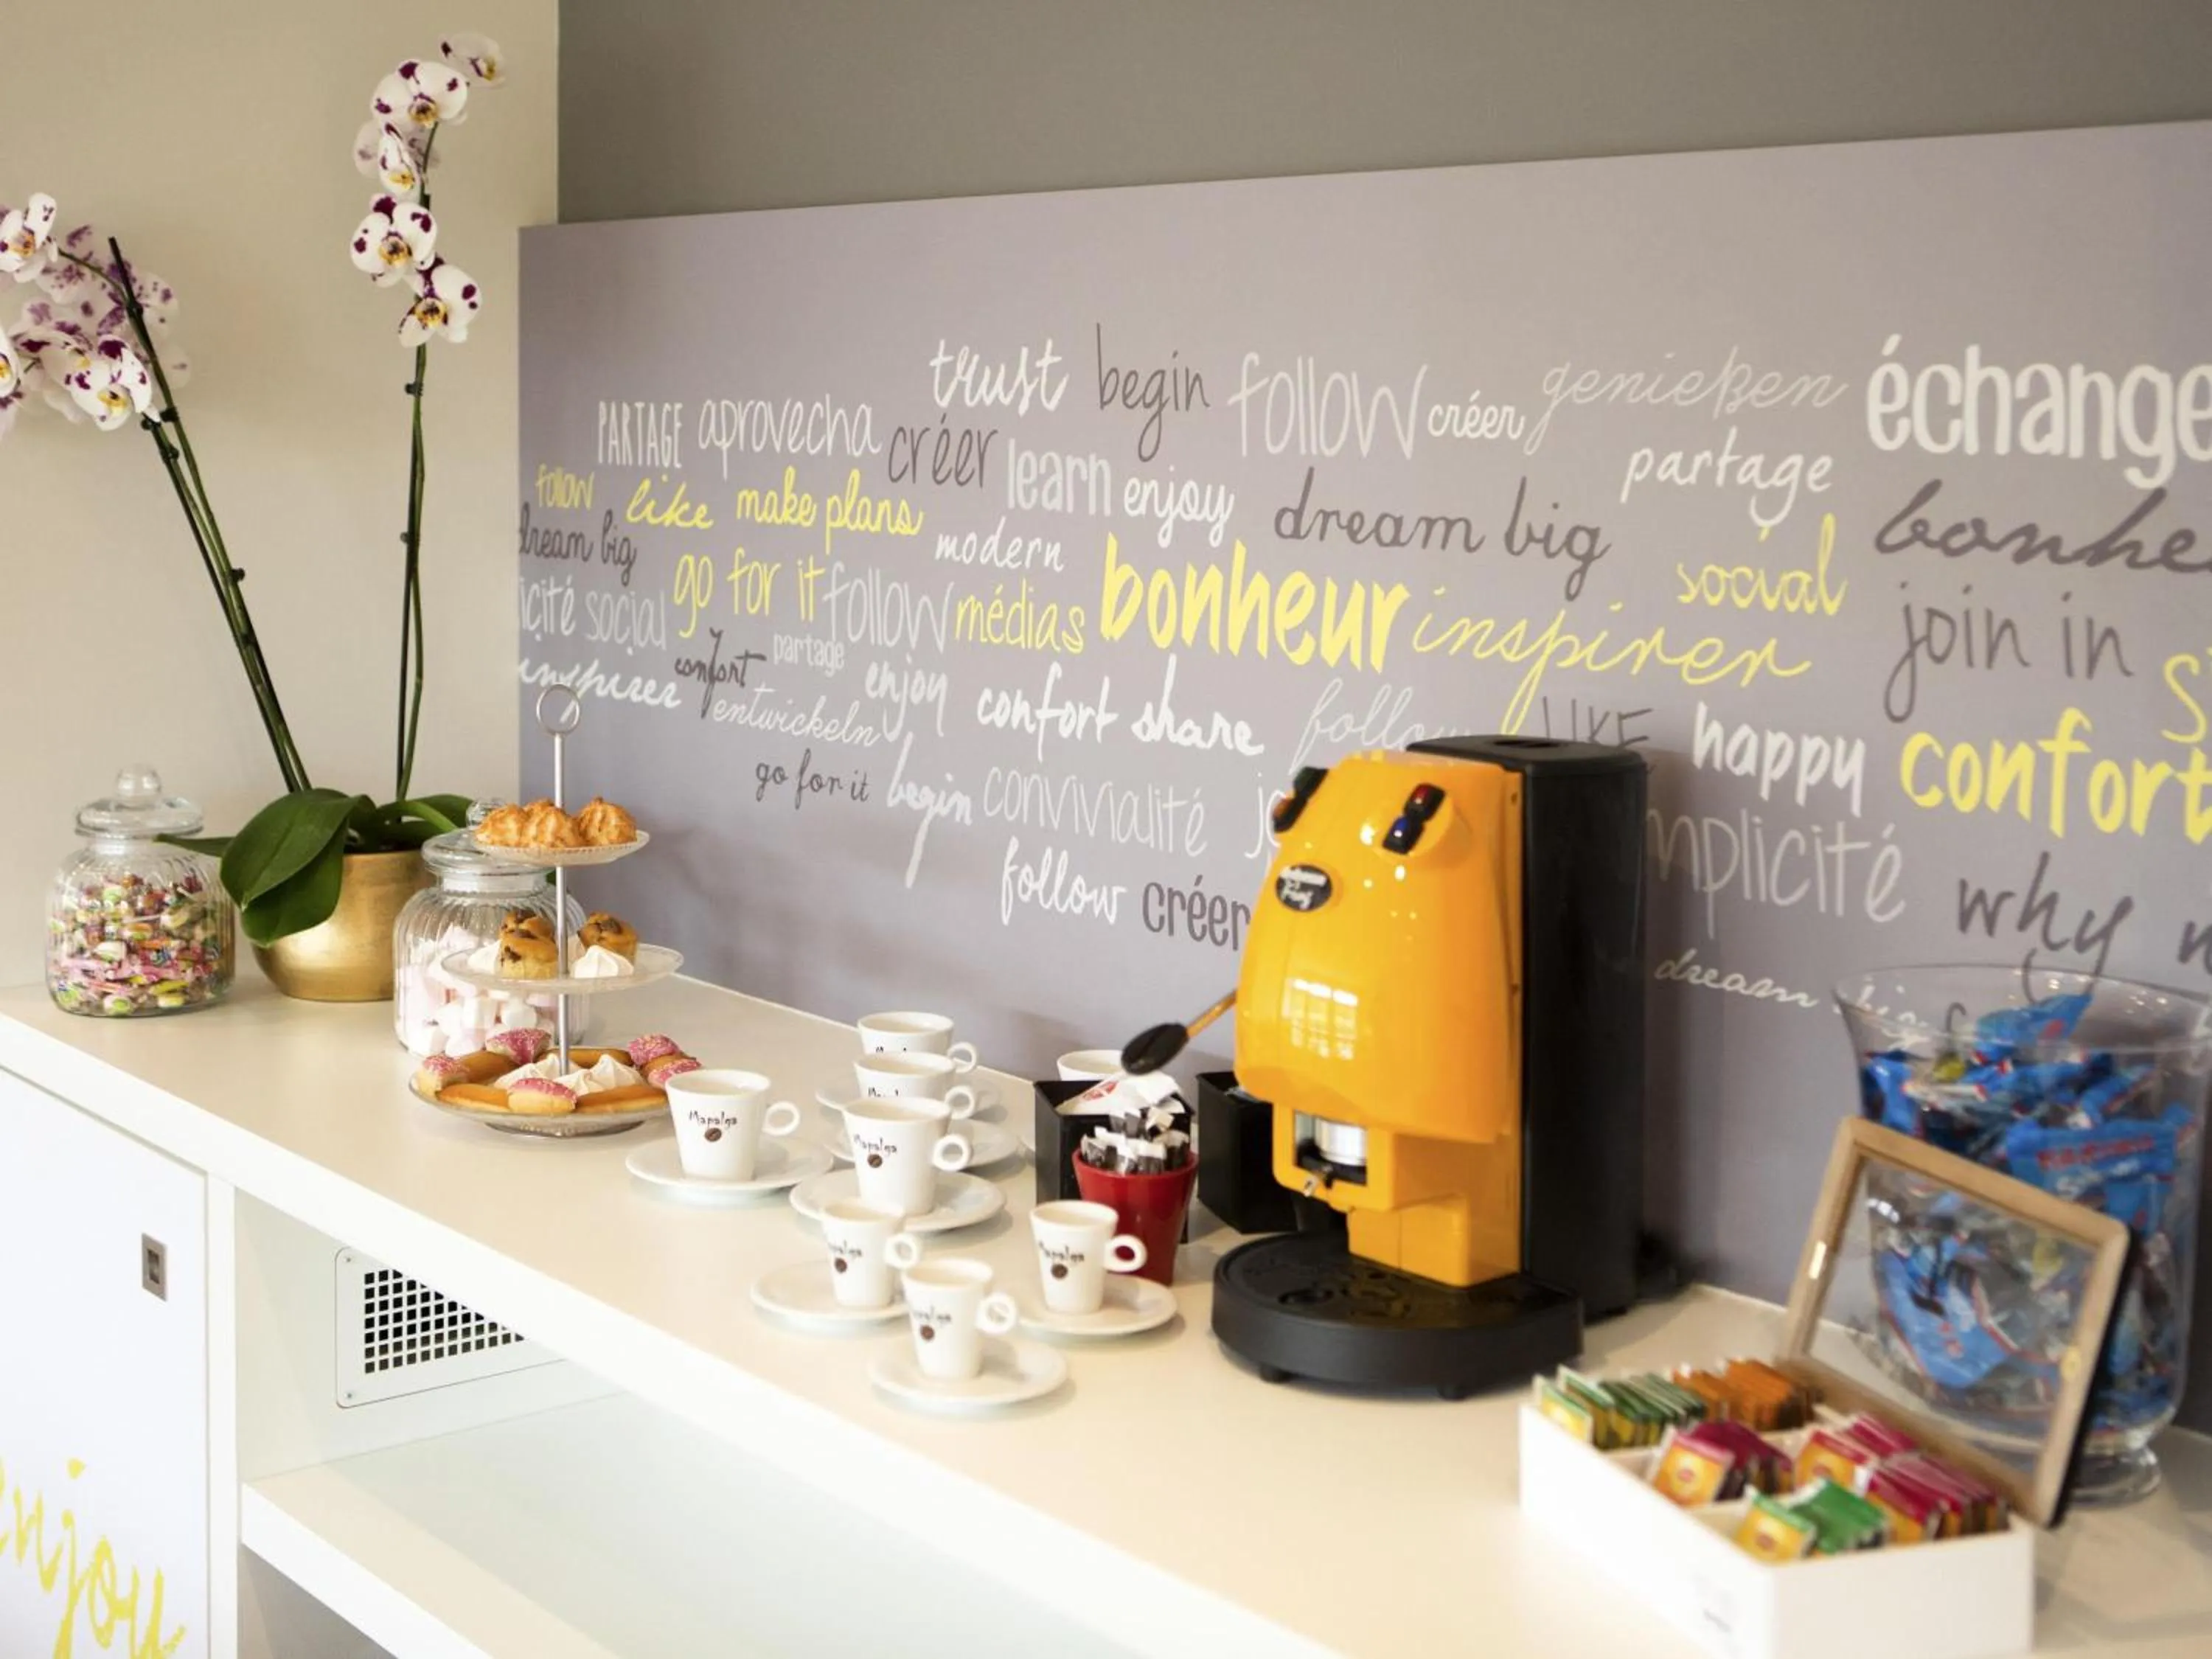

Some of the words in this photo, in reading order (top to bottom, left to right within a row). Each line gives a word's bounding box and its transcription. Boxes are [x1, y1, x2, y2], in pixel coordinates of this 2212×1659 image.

[929, 338, 1070, 417] trust
[1097, 323, 1211, 462] begin
[1227, 351, 1429, 459] follow
[1427, 389, 1526, 440] créer
[1867, 333, 2212, 490] échange
[598, 400, 683, 469] PARTAGE
[698, 393, 884, 481] aprovecha
[888, 412, 999, 489] créer
[1007, 437, 1111, 518] learn
[1620, 425, 1834, 529] partage
[625, 474, 714, 529] like
[737, 465, 817, 528] make
[825, 467, 925, 555] plans
[934, 515, 1065, 572] modern
[1124, 465, 1235, 549] enjoy
[1274, 465, 1486, 554] dream
[1503, 475, 1613, 602] big
[601, 508, 638, 588] big
[673, 554, 714, 639] go
[727, 546, 782, 616] for
[796, 554, 825, 622] it
[1677, 512, 1849, 616] social
[585, 590, 667, 651] social
[823, 560, 955, 654] follow
[956, 576, 1085, 654] médias
[1100, 534, 1411, 674] bonheur
[675, 627, 767, 718] confort
[773, 632, 846, 678] partage
[1412, 585, 1813, 736] inspirer
[1883, 580, 2032, 724] join
[2060, 591, 2135, 680] in
[713, 685, 881, 748] entwickeln
[865, 653, 949, 742] enjoy
[977, 661, 1119, 762] confort
[1131, 653, 1264, 756] share
[756, 761, 789, 803] go
[795, 748, 844, 810] for
[850, 771, 870, 802] it
[1692, 700, 1867, 818] happy
[1900, 706, 2212, 844] confort
[887, 731, 973, 889] begin
[1001, 835, 1128, 926] follow
[1141, 874, 1252, 952] créer
[1958, 850, 2135, 997] why
[1654, 947, 1820, 1009] dream
